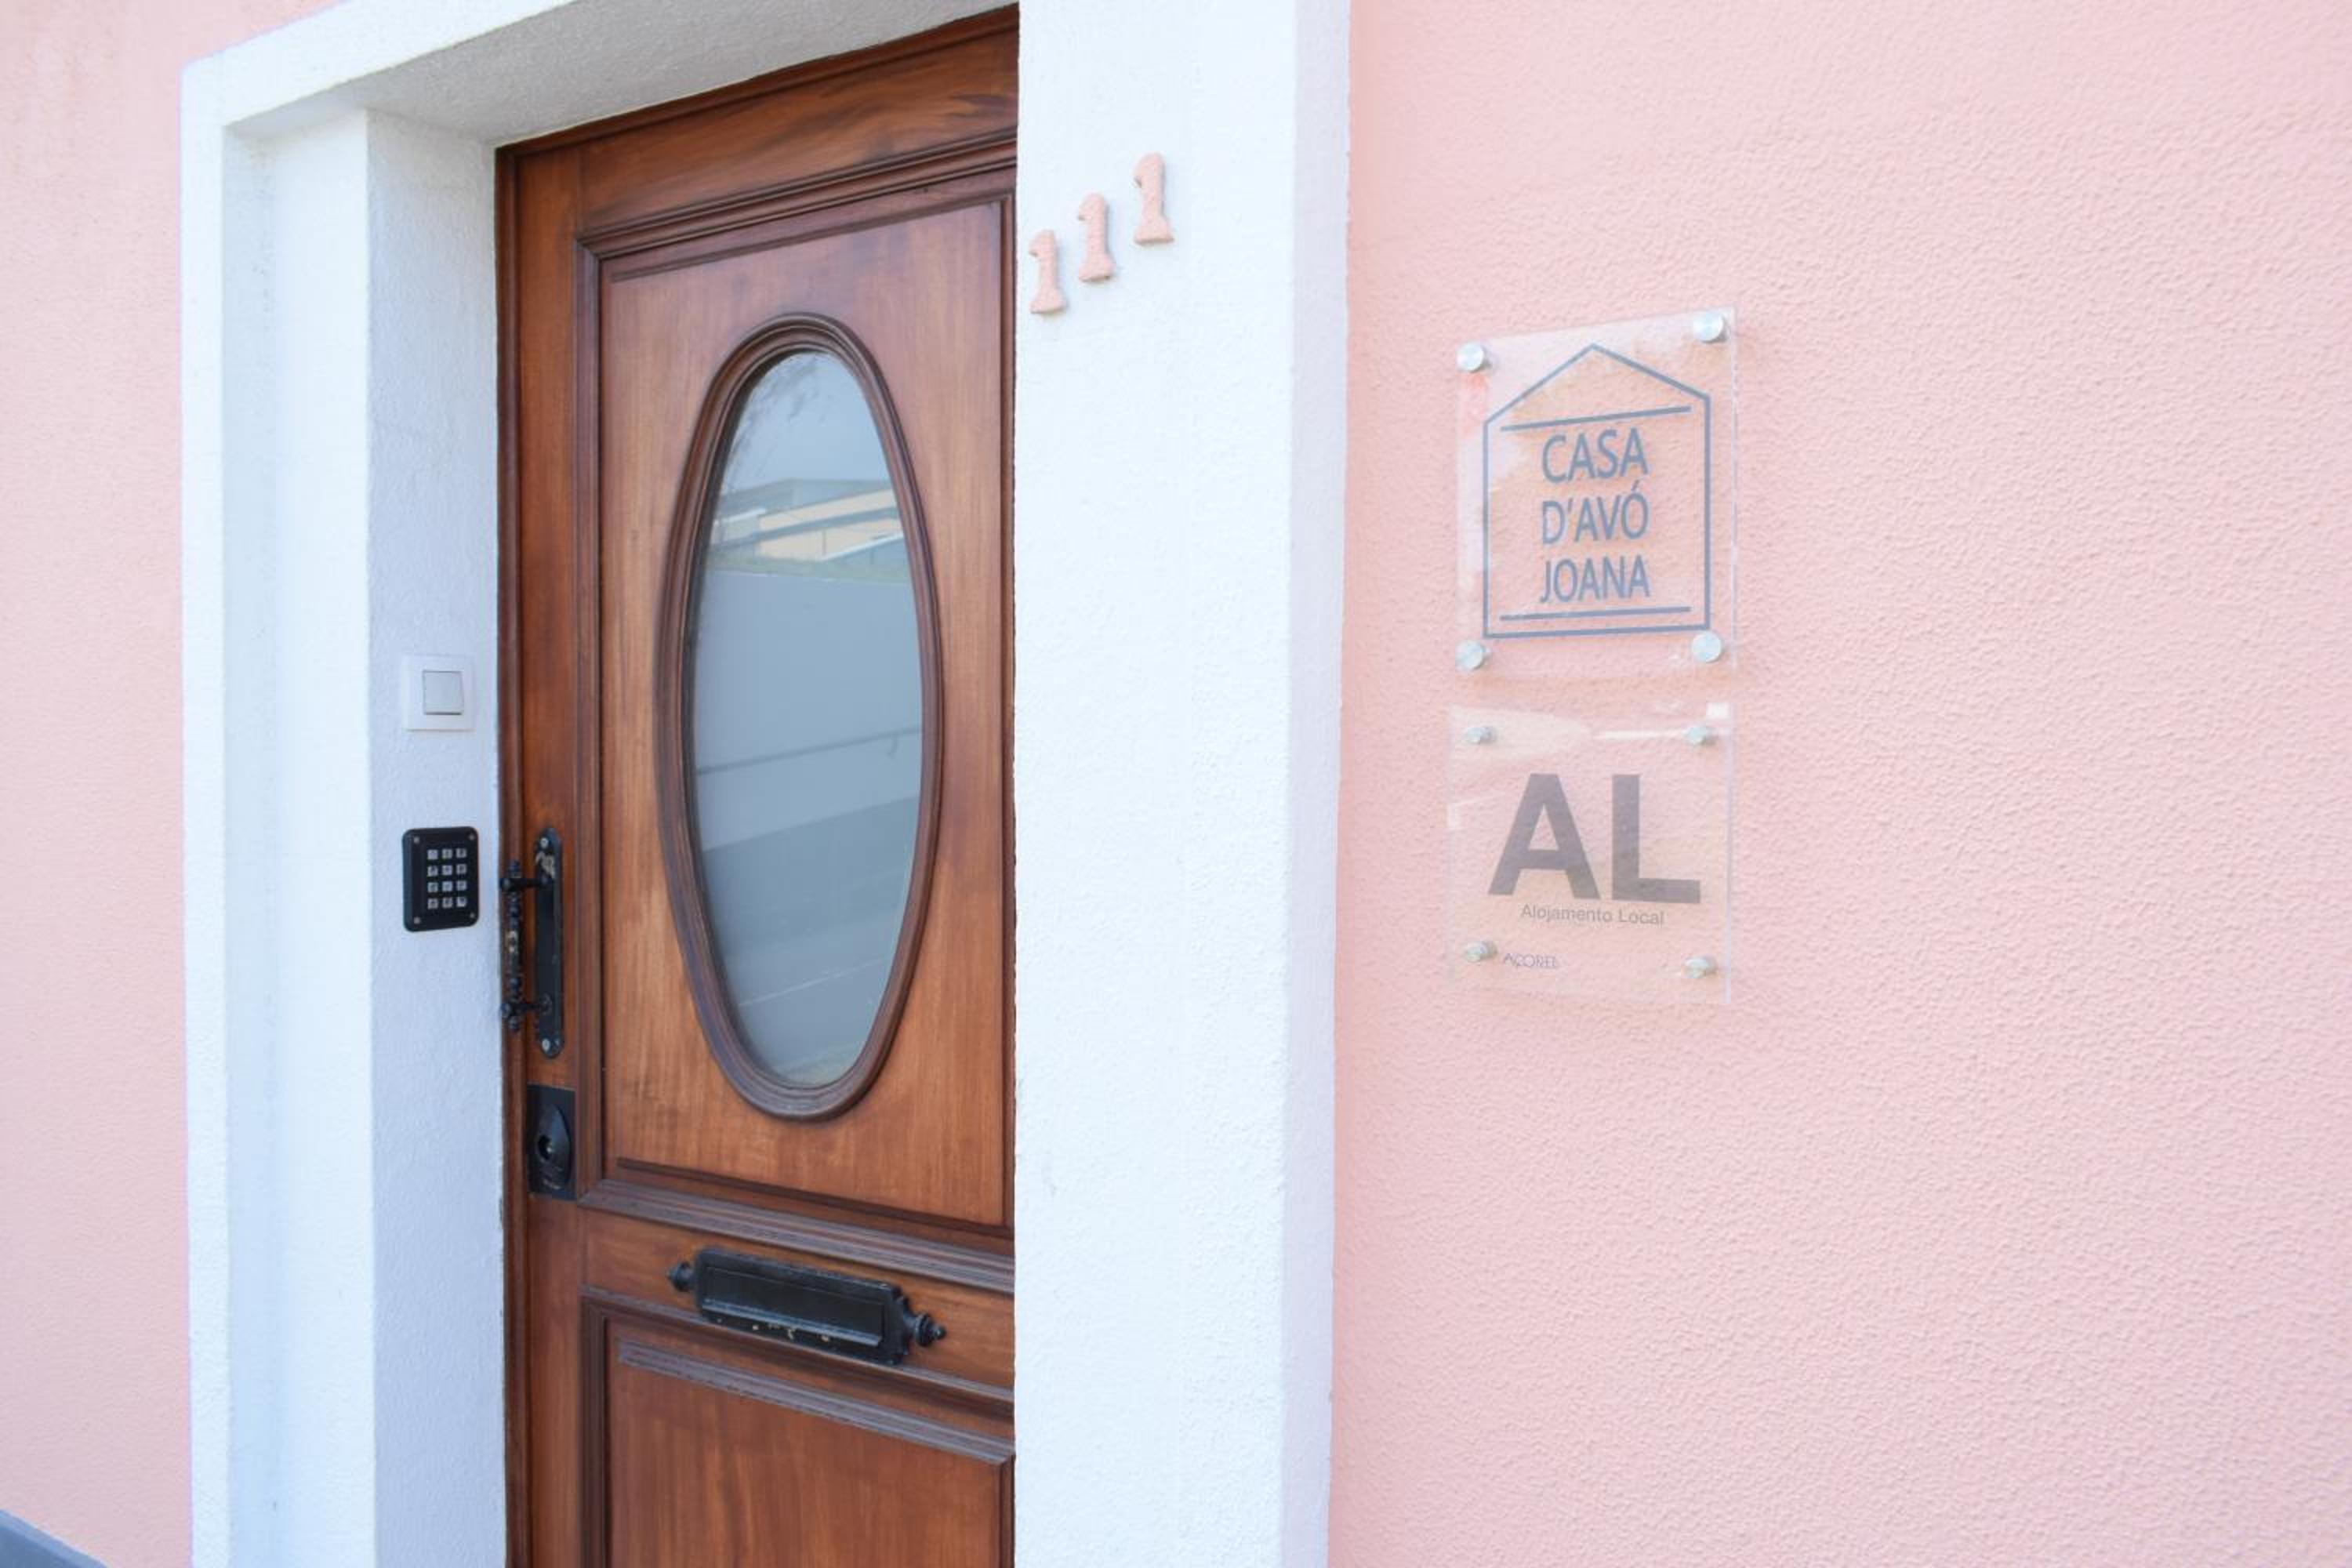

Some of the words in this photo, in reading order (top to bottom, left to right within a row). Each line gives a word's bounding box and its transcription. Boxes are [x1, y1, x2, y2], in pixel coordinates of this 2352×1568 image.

[1028, 152, 1174, 314] 111
[1542, 427, 1648, 483] CASA
[1541, 481, 1648, 544] D'AVÓ
[1540, 555, 1650, 603] JOANA
[1488, 773, 1701, 904] AL
[1520, 904, 1613, 923] Alojamento
[1618, 907, 1664, 925] Local
